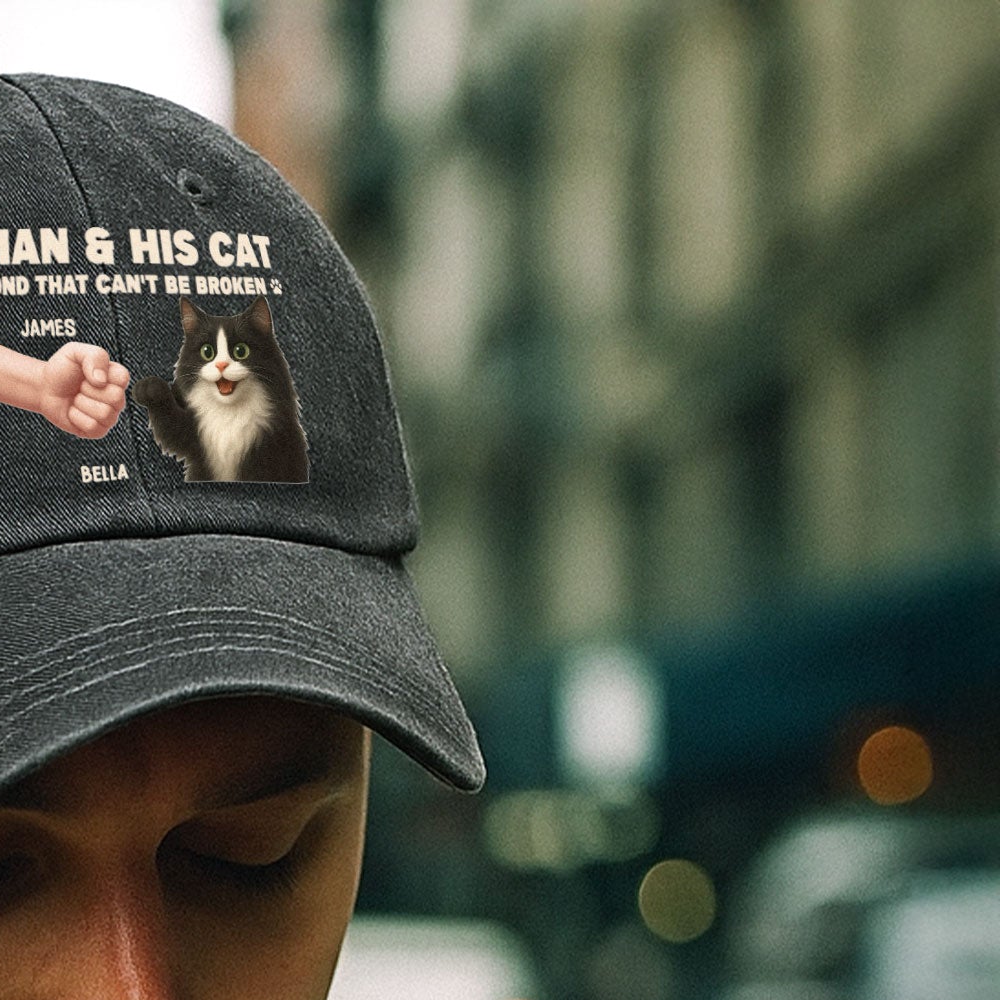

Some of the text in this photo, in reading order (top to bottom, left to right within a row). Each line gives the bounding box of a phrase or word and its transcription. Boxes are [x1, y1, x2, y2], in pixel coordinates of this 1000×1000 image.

[84, 226, 115, 266] &
[129, 228, 200, 267] HIS
[208, 231, 272, 269] CAT
[34, 274, 89, 296] THAT
[95, 273, 159, 295] CAN'T
[164, 274, 191, 295] BE
[195, 275, 268, 296] BROKEN
[20, 318, 77, 338] JAMES
[80, 463, 129, 483] BELLA
